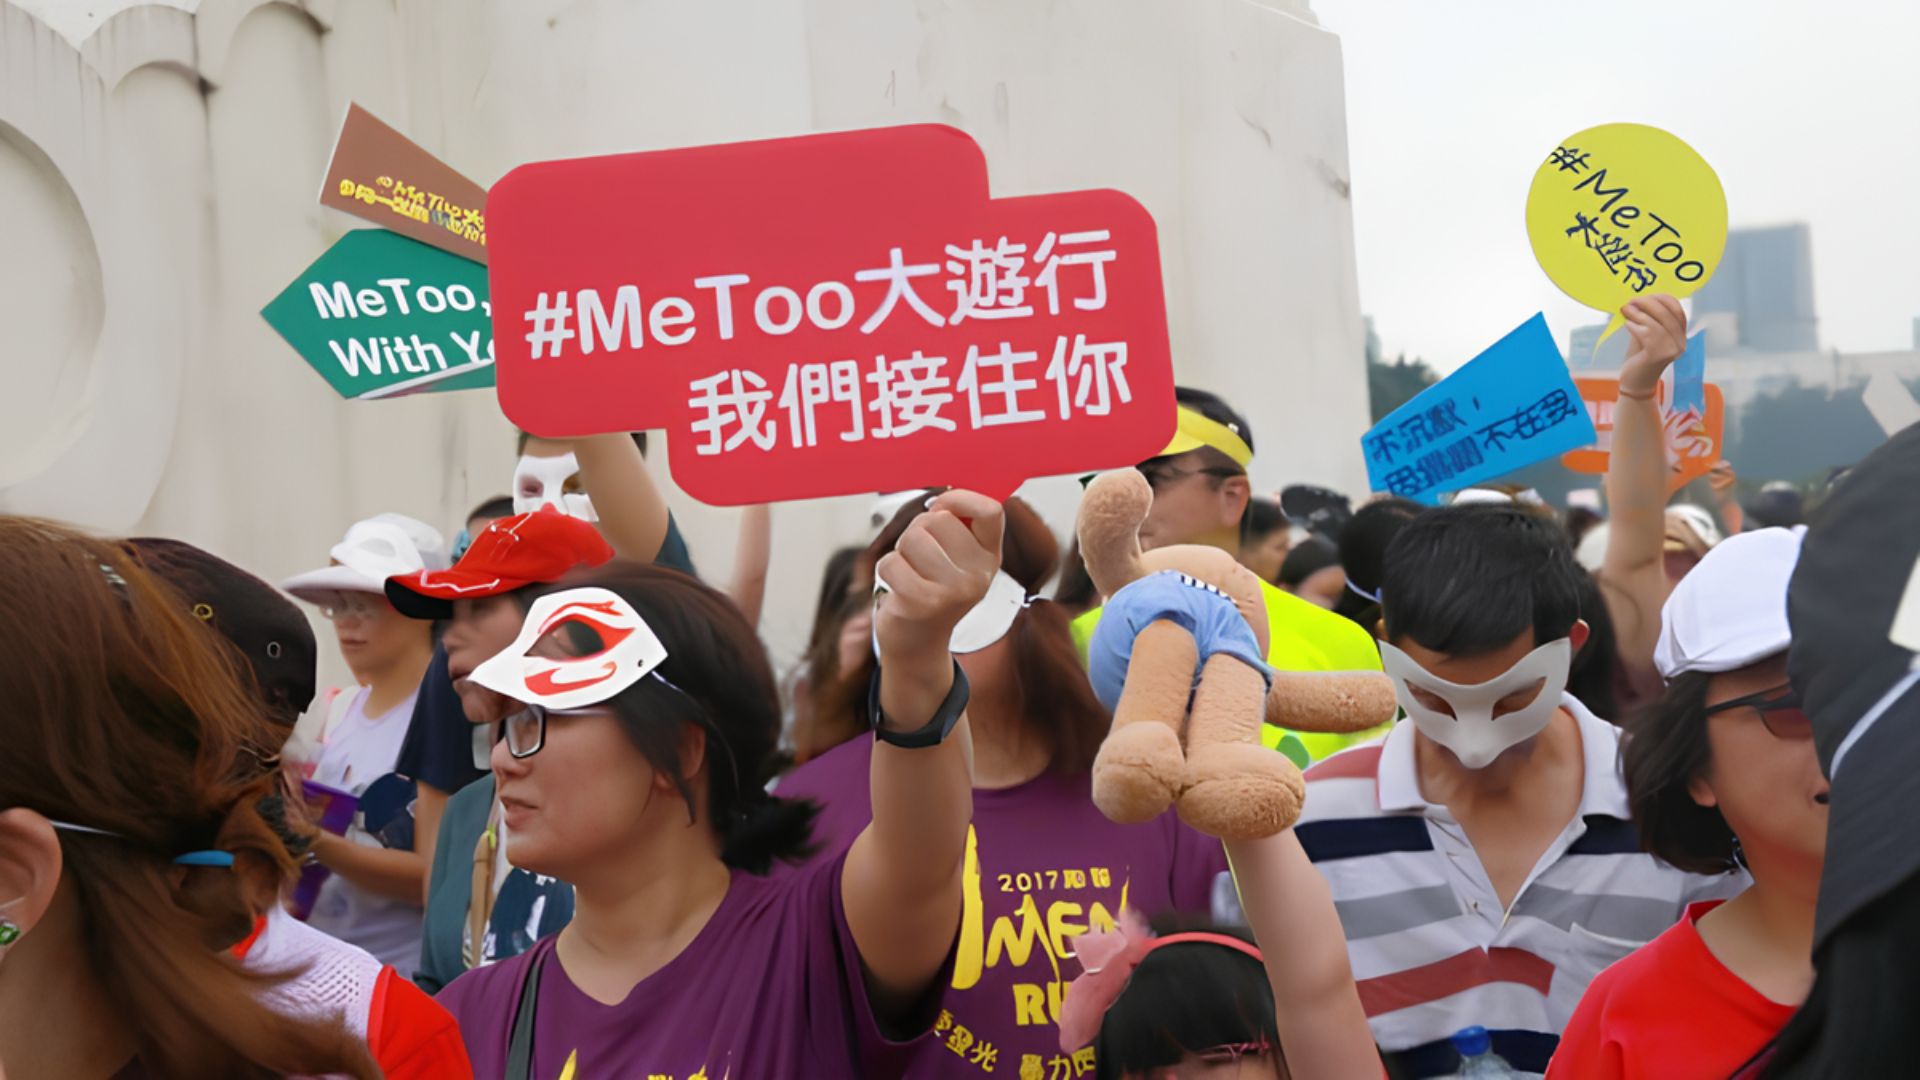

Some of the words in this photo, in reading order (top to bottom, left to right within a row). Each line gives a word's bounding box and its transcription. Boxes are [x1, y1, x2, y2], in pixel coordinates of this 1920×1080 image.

[1550, 146, 1704, 282] #MeToo
[327, 334, 448, 378] With
[523, 229, 1117, 359] #MeToo大遊行
[688, 333, 1132, 456] 我們接住你
